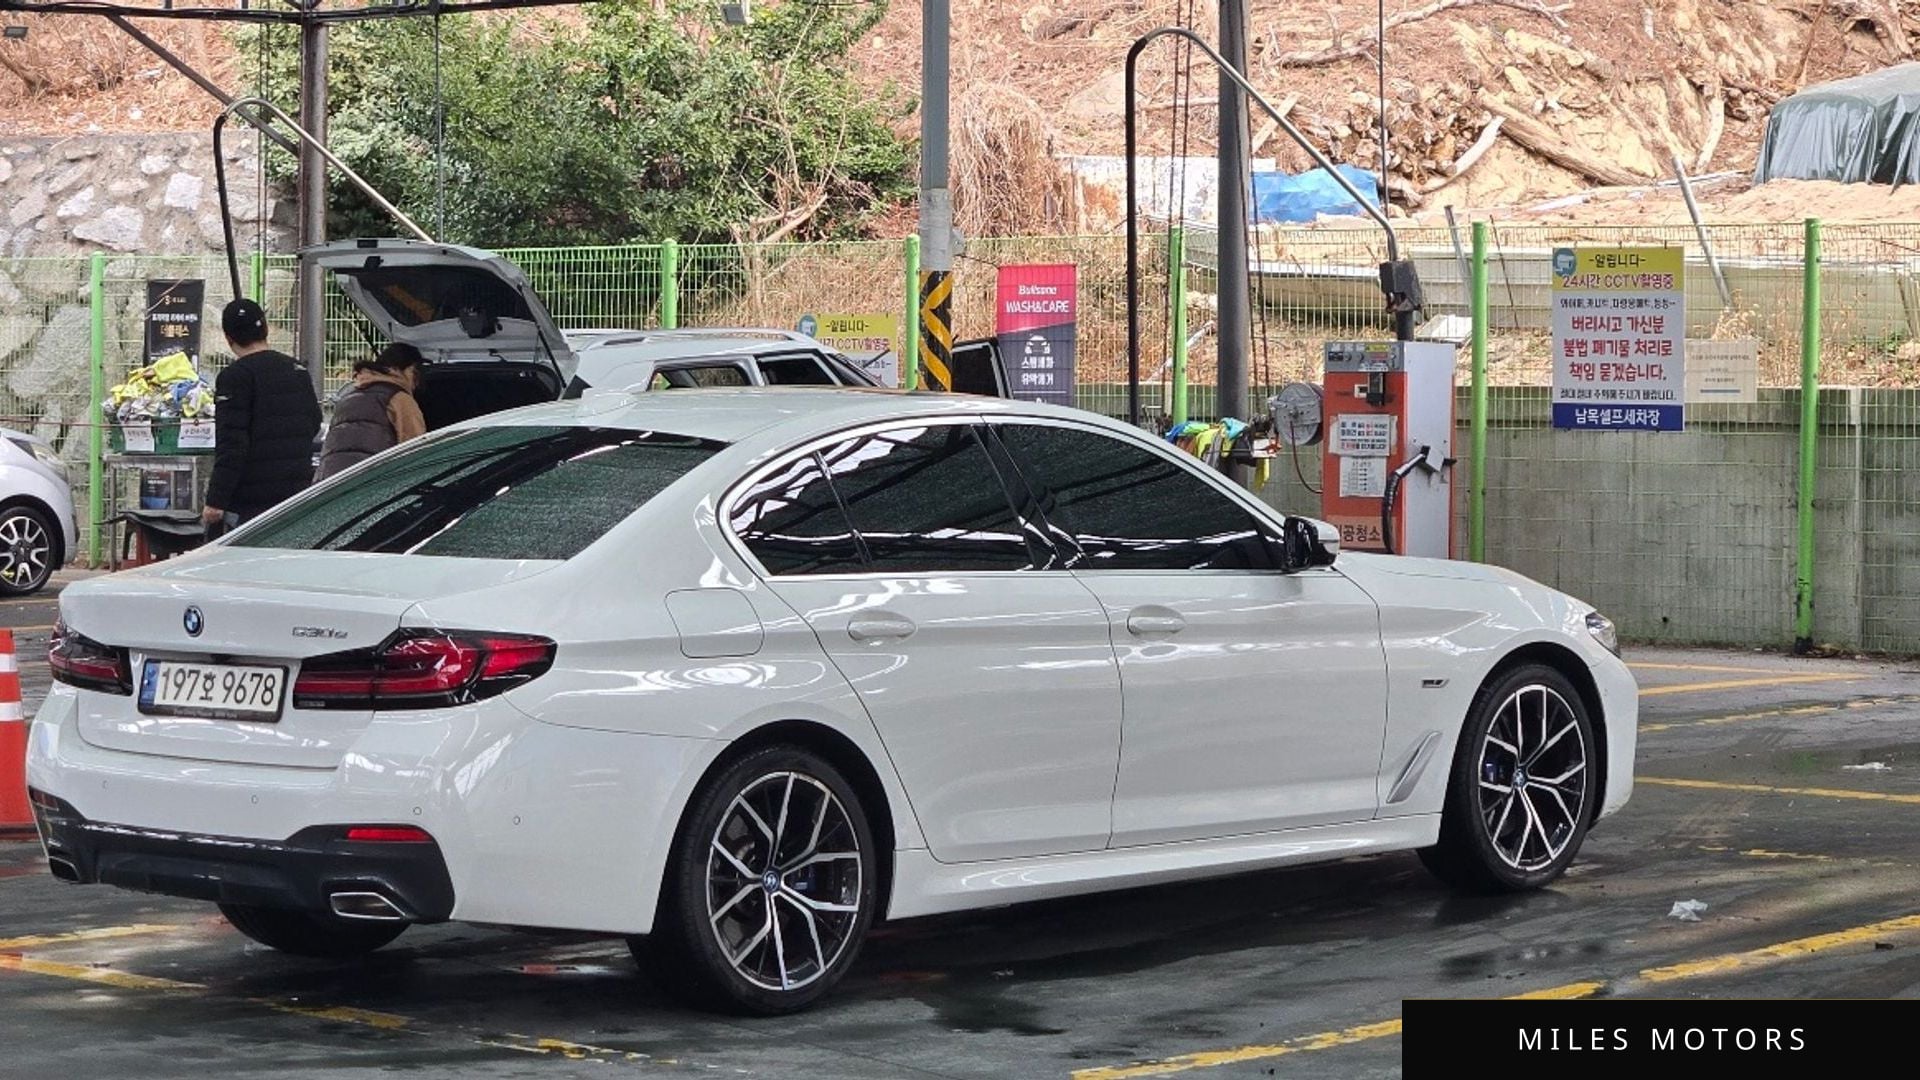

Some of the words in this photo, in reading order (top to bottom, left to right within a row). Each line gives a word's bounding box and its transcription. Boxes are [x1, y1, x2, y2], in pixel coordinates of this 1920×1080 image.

[1563, 275, 1601, 288] 24시간
[1604, 274, 1674, 289] CCTV촬영중
[1006, 300, 1070, 313] WASH&CARE
[1571, 315, 1622, 333] 버리시고
[1627, 315, 1664, 334] 가신분
[1563, 339, 1588, 356] 불법
[1592, 339, 1631, 356] 폐기물
[1635, 339, 1673, 356] 처리로
[1569, 362, 1596, 381] 책임
[1600, 363, 1667, 382] 묻겠습니다.
[1575, 408, 1660, 425] 남목셀프세차장
[160, 668, 216, 701] 197호
[221, 671, 276, 706] 9678
